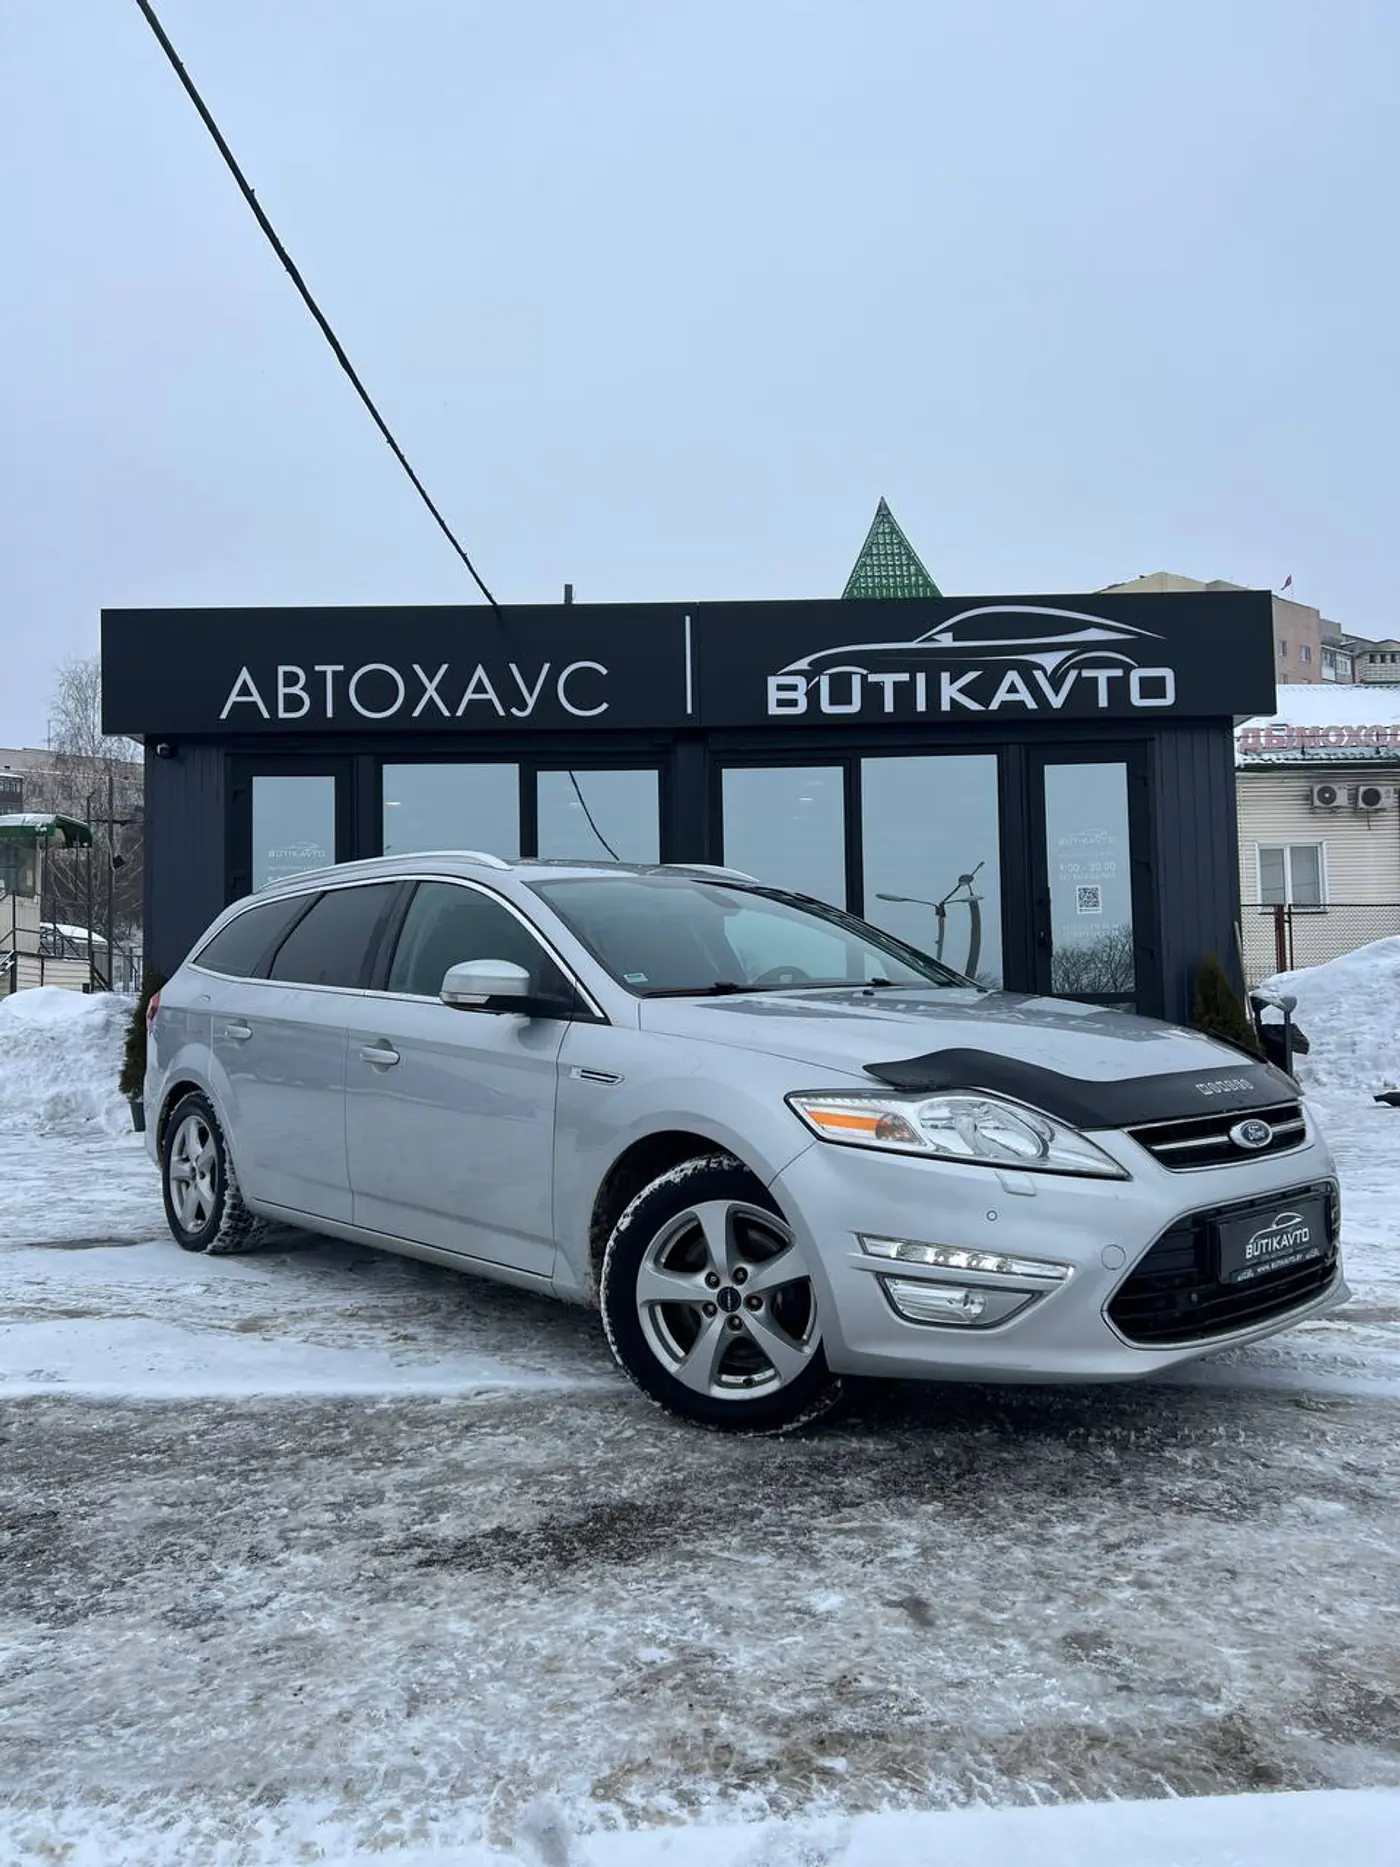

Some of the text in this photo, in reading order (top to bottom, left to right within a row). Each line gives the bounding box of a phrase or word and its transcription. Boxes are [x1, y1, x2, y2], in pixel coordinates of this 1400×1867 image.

[219, 660, 609, 719] АВТОХАУС
[766, 667, 1176, 716] BUTIKAVTO
[1247, 1124, 1266, 1141] Ford
[1245, 1227, 1310, 1259] BUTIKAVTO
